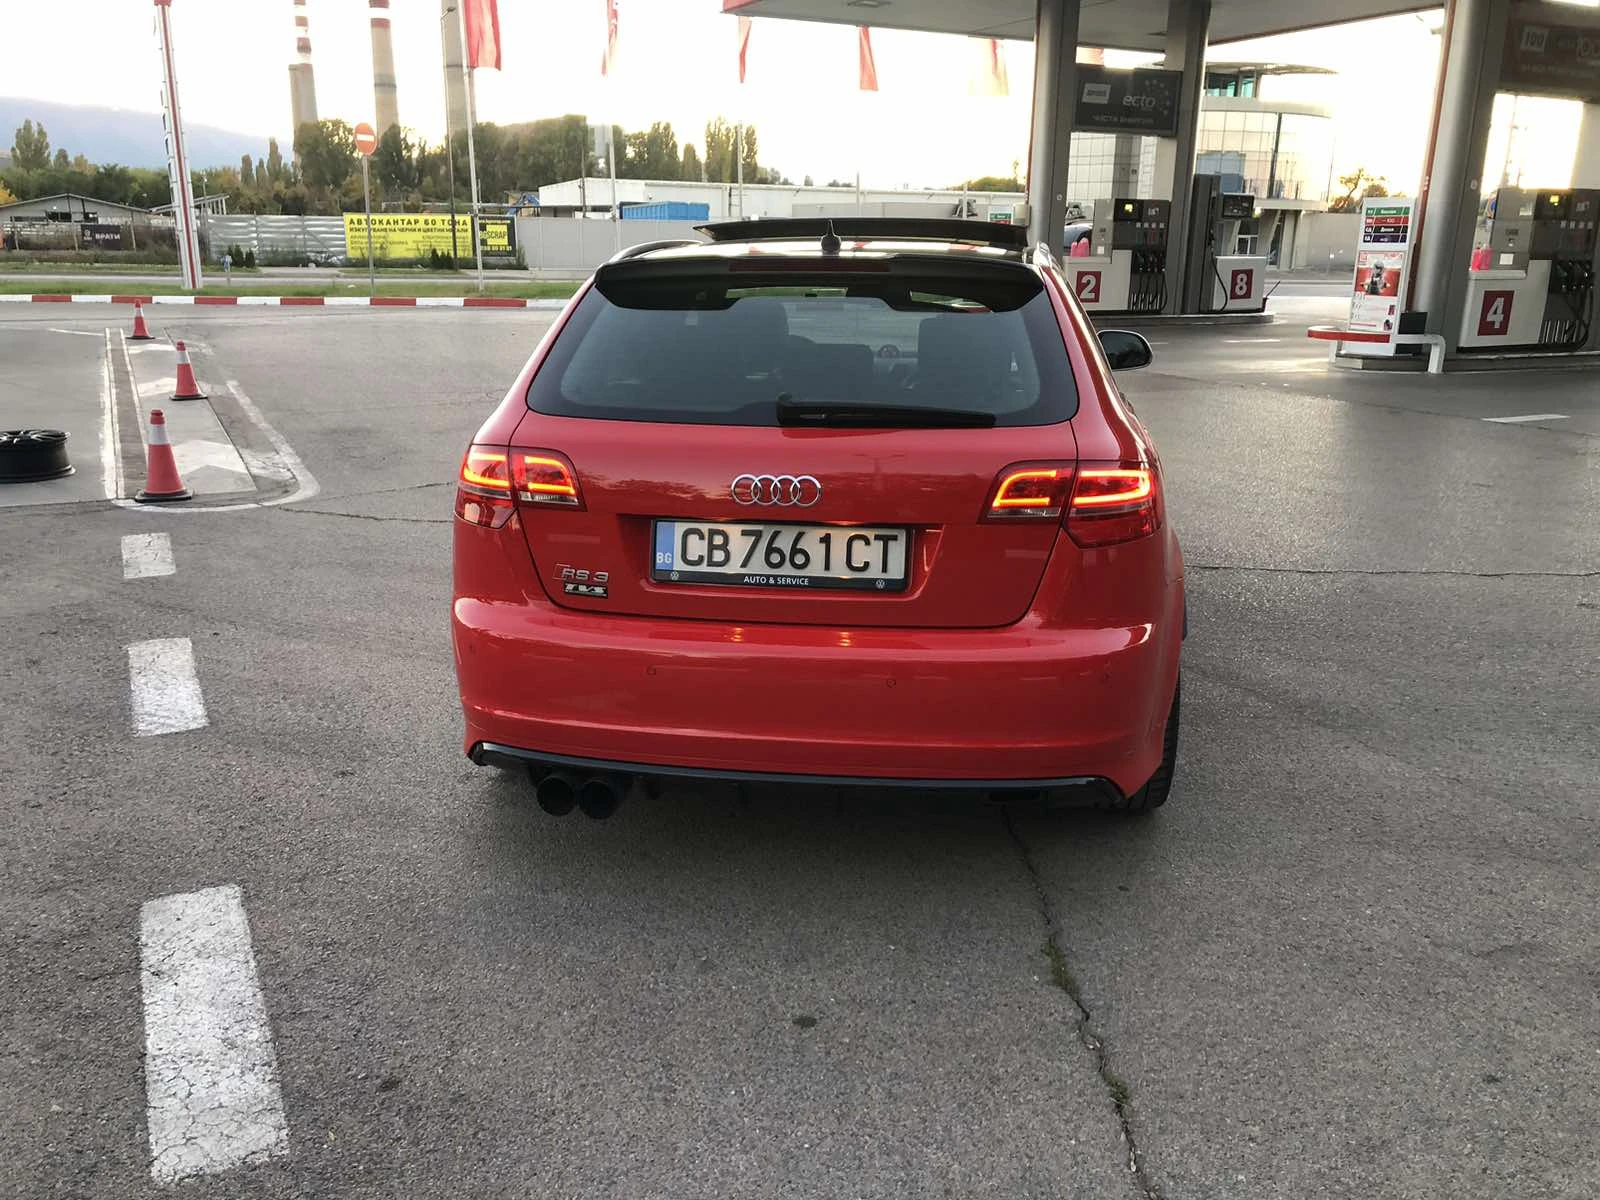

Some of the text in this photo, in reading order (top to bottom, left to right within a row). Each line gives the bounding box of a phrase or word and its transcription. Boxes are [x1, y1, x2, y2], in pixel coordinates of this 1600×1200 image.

[1122, 95, 1156, 108] ecto
[349, 218, 420, 226] АВТОКАНТАР
[1079, 275, 1097, 299] 2
[1234, 273, 1248, 296] 8
[1486, 297, 1505, 328] 4
[656, 552, 672, 563] BG
[743, 576, 809, 585] AUTO & SERVICE
